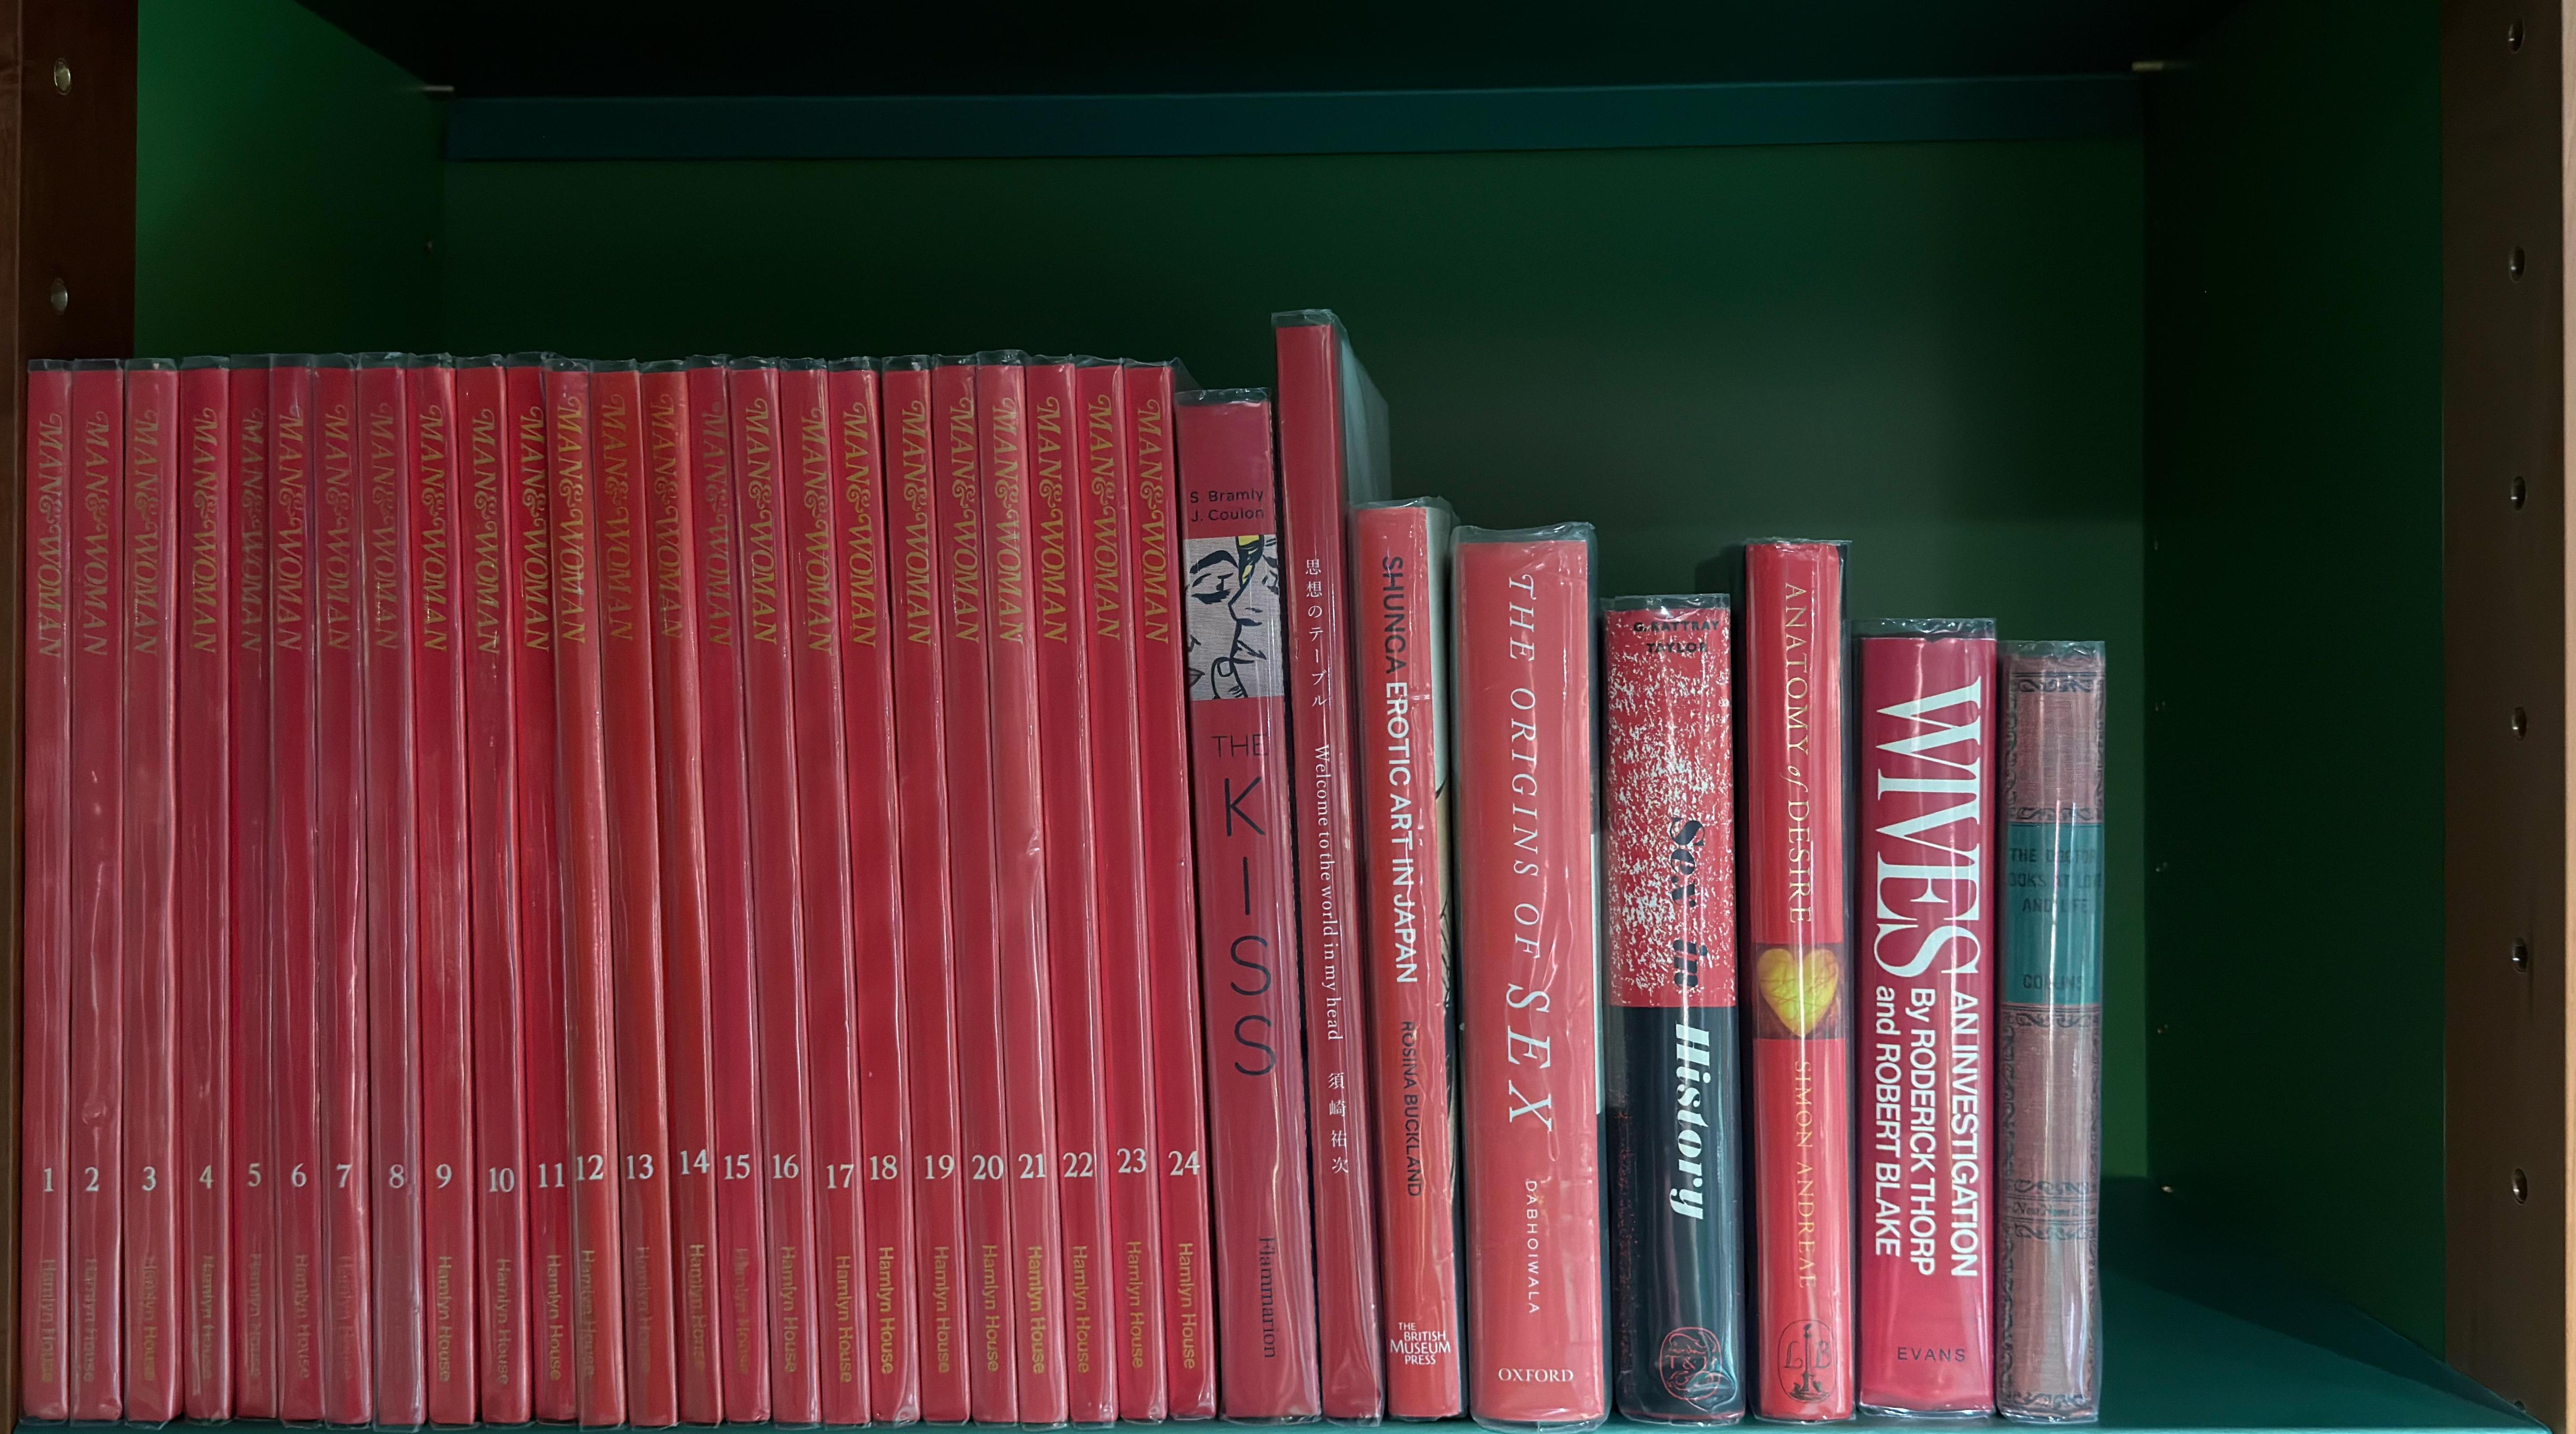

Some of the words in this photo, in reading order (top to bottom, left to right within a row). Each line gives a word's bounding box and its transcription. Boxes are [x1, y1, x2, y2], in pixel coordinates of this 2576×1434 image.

[1208, 488, 1263, 503] Bramly
[1208, 510, 1264, 521] Coulon
[1306, 559, 1328, 707] 思想のテーブル
[1383, 556, 1406, 674] SHUNGA
[1508, 574, 1536, 661] THE
[1651, 621, 1719, 631] RATTRAY
[1646, 642, 1707, 653] TAYLOR
[1785, 583, 1809, 756] ANATOMY
[1212, 734, 1269, 758] THE
[1386, 683, 1410, 786] EROTIC
[1315, 744, 1331, 826] Welcome
[1510, 688, 1539, 877] ORIGINS
[1781, 765, 1808, 793] of
[1319, 832, 1329, 848] to
[1390, 793, 1413, 850] ART
[1874, 676, 1981, 978] WIVES
[1319, 851, 1331, 882] the
[1393, 859, 1413, 885] IN
[1788, 800, 1812, 924] DESIRE
[2009, 848, 2036, 862] THE
[1224, 776, 1276, 1076] KISS
[1323, 886, 1337, 936] world
[1514, 902, 1540, 959] OF
[2023, 899, 2052, 912] AND
[1325, 943, 1336, 959] in
[1394, 893, 1418, 983] JAPAN
[1673, 939, 1707, 988] in
[1322, 965, 1336, 991] my
[1905, 988, 1936, 1022] By
[1327, 997, 1344, 1041] head
[1876, 986, 1901, 1035] and
[1952, 991, 1978, 1034] AN
[1402, 1021, 1418, 1089] ROSINA
[1506, 983, 1552, 1132] SEX
[1670, 1022, 1710, 1220] History
[1795, 1061, 1813, 1149] SIMON
[1875, 1044, 1901, 1158] ROBERT
[1909, 1029, 1936, 1172] RODERICK
[576, 1155, 604, 1181] 12
[627, 1154, 653, 1179] 13
[680, 1150, 709, 1175] 14
[724, 1154, 750, 1179] 15
[773, 1154, 798, 1179] 16
[870, 1155, 897, 1180] 18
[925, 1155, 954, 1179] 19
[973, 1155, 1003, 1180] 20
[1018, 1154, 1045, 1179] 21
[1063, 1152, 1093, 1178] 22
[1117, 1148, 1147, 1174] 23
[1168, 1151, 1200, 1176] 24
[1404, 1094, 1421, 1197] BUCKLAND
[1951, 1045, 1978, 1276] INVESTIGATION
[44, 1167, 53, 1192] 1
[86, 1167, 99, 1192] 2
[142, 1166, 157, 1191] 3
[199, 1165, 213, 1189] 4
[248, 1163, 261, 1187] 5
[292, 1163, 306, 1187] 6
[336, 1164, 351, 1188] 7
[389, 1164, 404, 1188] 8
[437, 1164, 451, 1188] 9
[489, 1167, 515, 1192] 10
[539, 1163, 564, 1188] 11
[827, 1164, 854, 1189] 17
[1797, 1161, 1816, 1288] ANDREAE
[1875, 1167, 1901, 1256] BLAKE
[1910, 1179, 1936, 1275] THORP
[1125, 1241, 1143, 1307] Hamlyn
[1525, 1180, 1540, 1314] DABHOIWALA
[438, 1256, 452, 1321] Hamlyn
[496, 1259, 512, 1324] Hamlyn
[546, 1255, 561, 1320] Hamlyn
[689, 1244, 705, 1313] Hamlyn
[781, 1247, 797, 1313] Hamlyn
[835, 1256, 852, 1321] Hamlyn
[876, 1247, 894, 1312] Hamlyn
[932, 1247, 949, 1313] Hamlyn
[982, 1245, 999, 1310] Hamlyn
[1026, 1246, 1045, 1313] Hamlyn
[1073, 1246, 1089, 1312] Hamlyn
[1177, 1243, 1194, 1308] Hamlyn
[1259, 1238, 1276, 1358] Flammarion
[438, 1327, 452, 1382] House
[497, 1329, 511, 1385] House
[549, 1325, 564, 1381] House
[784, 1318, 798, 1372] House
[839, 1327, 853, 1382] House
[880, 1317, 895, 1374] House
[936, 1317, 950, 1373] House
[986, 1316, 999, 1372] House
[1031, 1317, 1045, 1374] House
[1076, 1316, 1090, 1373] House
[1129, 1312, 1144, 1368] House
[1182, 1314, 1197, 1369] House
[1390, 1339, 1451, 1354] MUSEUM
[1404, 1331, 1446, 1341] BRITISH
[1405, 1355, 1435, 1365] PRESS
[1897, 1346, 1966, 1361] EVANS
[1498, 1368, 1574, 1383] OXFORD
